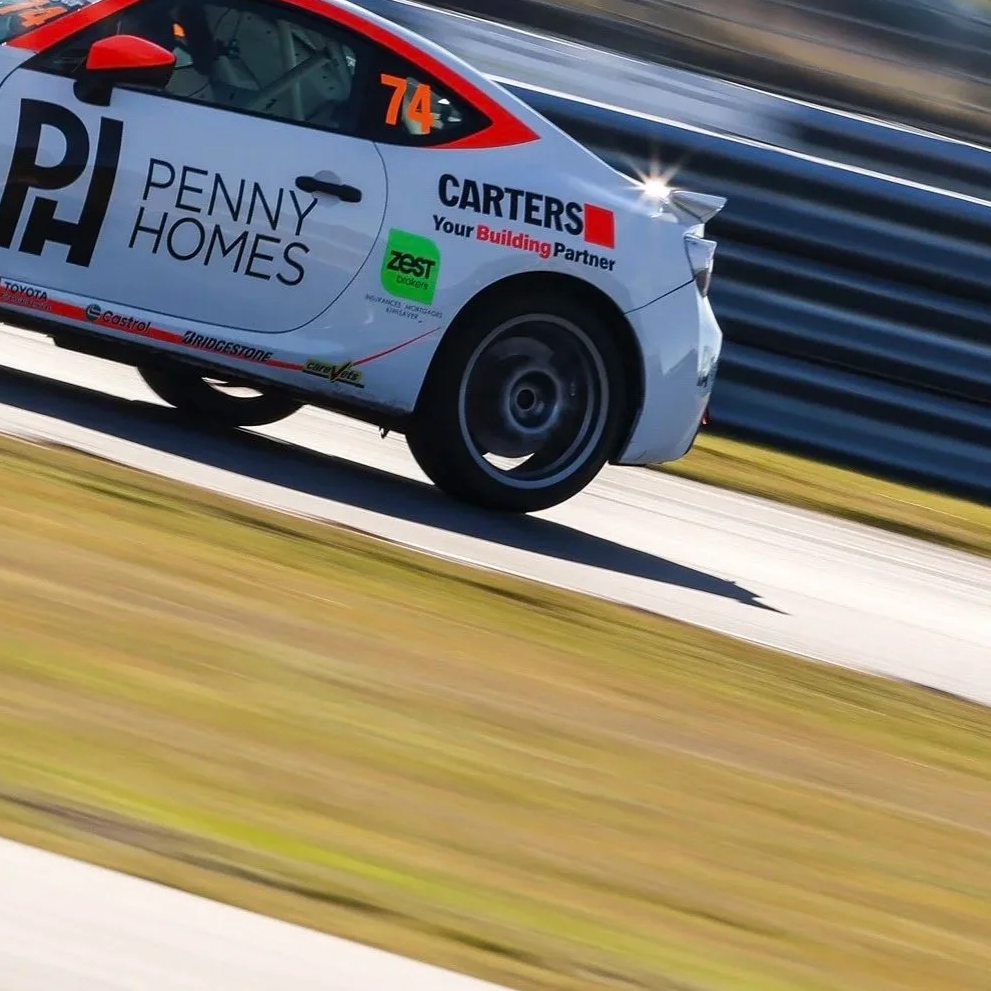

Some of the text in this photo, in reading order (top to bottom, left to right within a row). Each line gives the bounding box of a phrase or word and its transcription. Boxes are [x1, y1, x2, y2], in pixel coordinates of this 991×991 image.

[380, 73, 432, 135] 74
[143, 158, 318, 236] PENNY
[438, 174, 584, 236] CARTERS
[128, 206, 310, 287] HOMES
[433, 215, 616, 272] Your Building Partner
[4, 281, 48, 301] TOYOTA
[396, 274, 429, 290] brokers
[101, 310, 152, 333] Castrol
[182, 330, 274, 361] BRIDGESTONE
